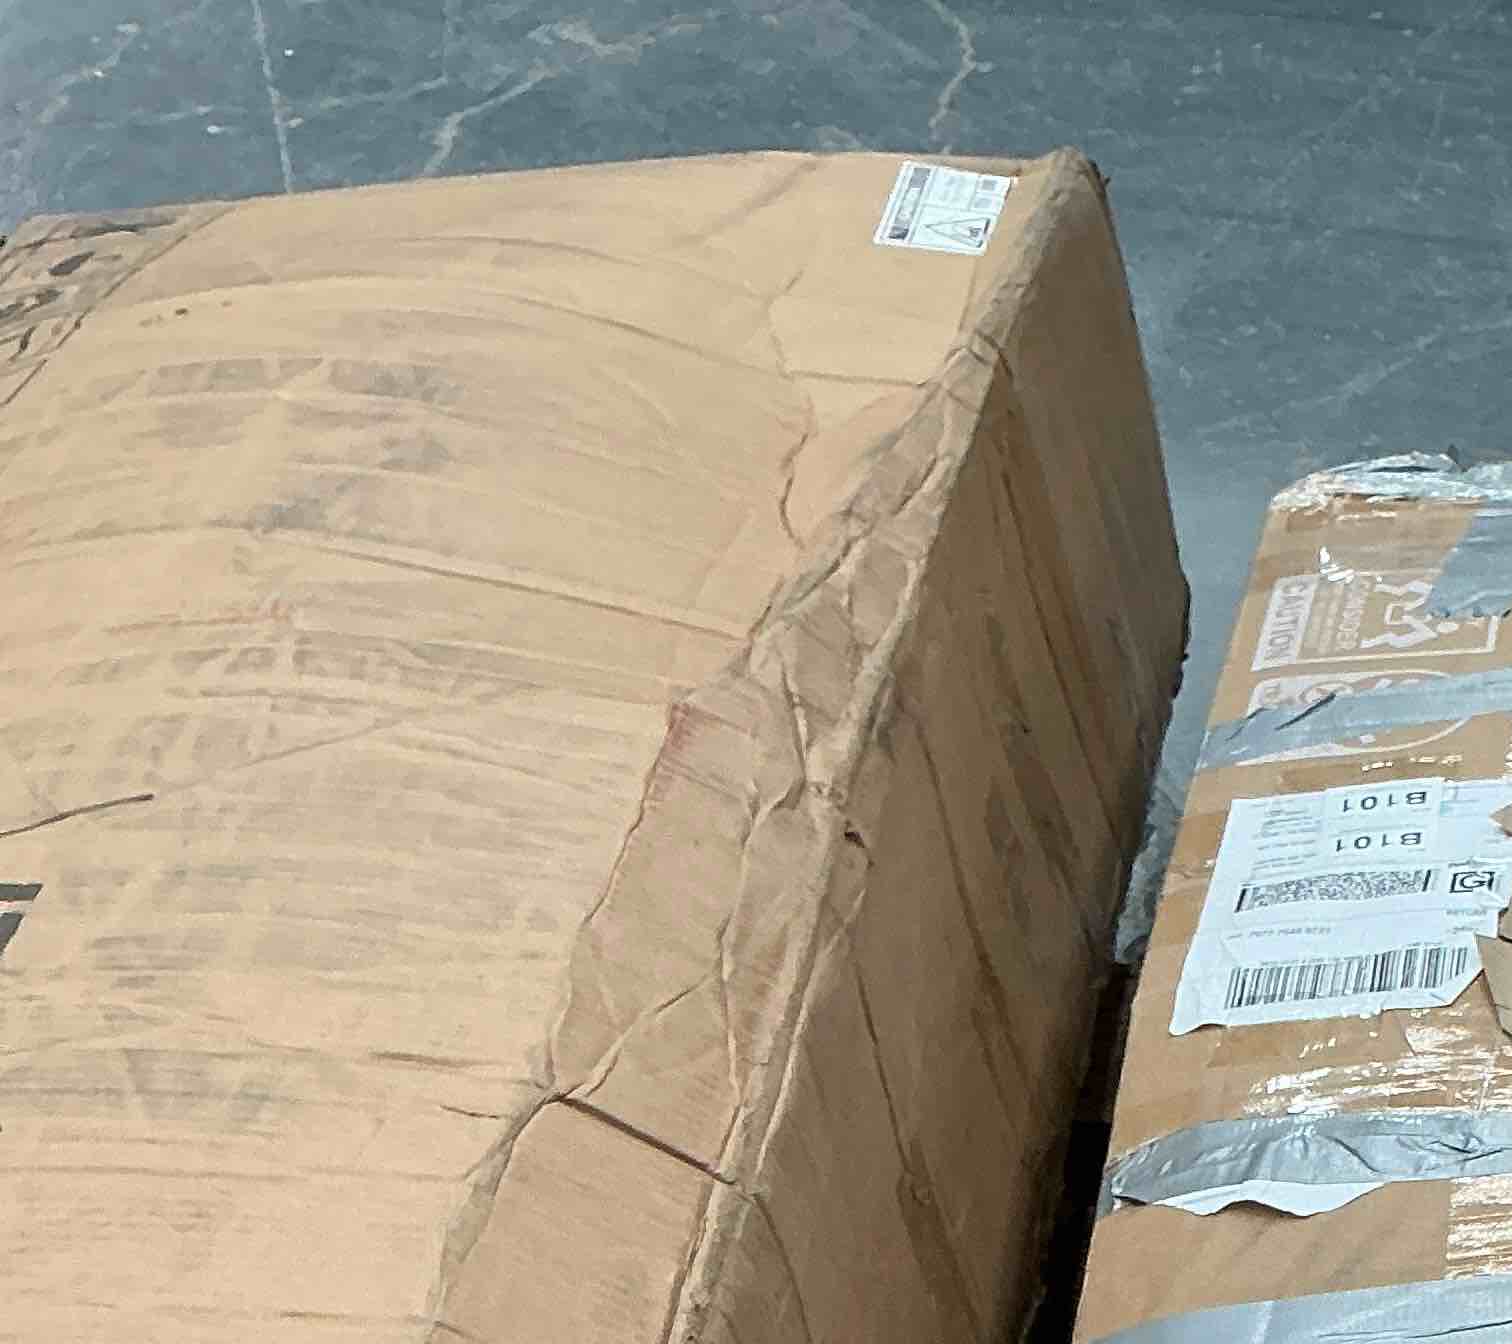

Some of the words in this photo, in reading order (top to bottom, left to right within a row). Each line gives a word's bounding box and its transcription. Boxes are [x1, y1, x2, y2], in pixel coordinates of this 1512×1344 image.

[1265, 580, 1308, 662] CAUTION
[1342, 790, 1428, 813] B101
[1335, 831, 1422, 854] B101
